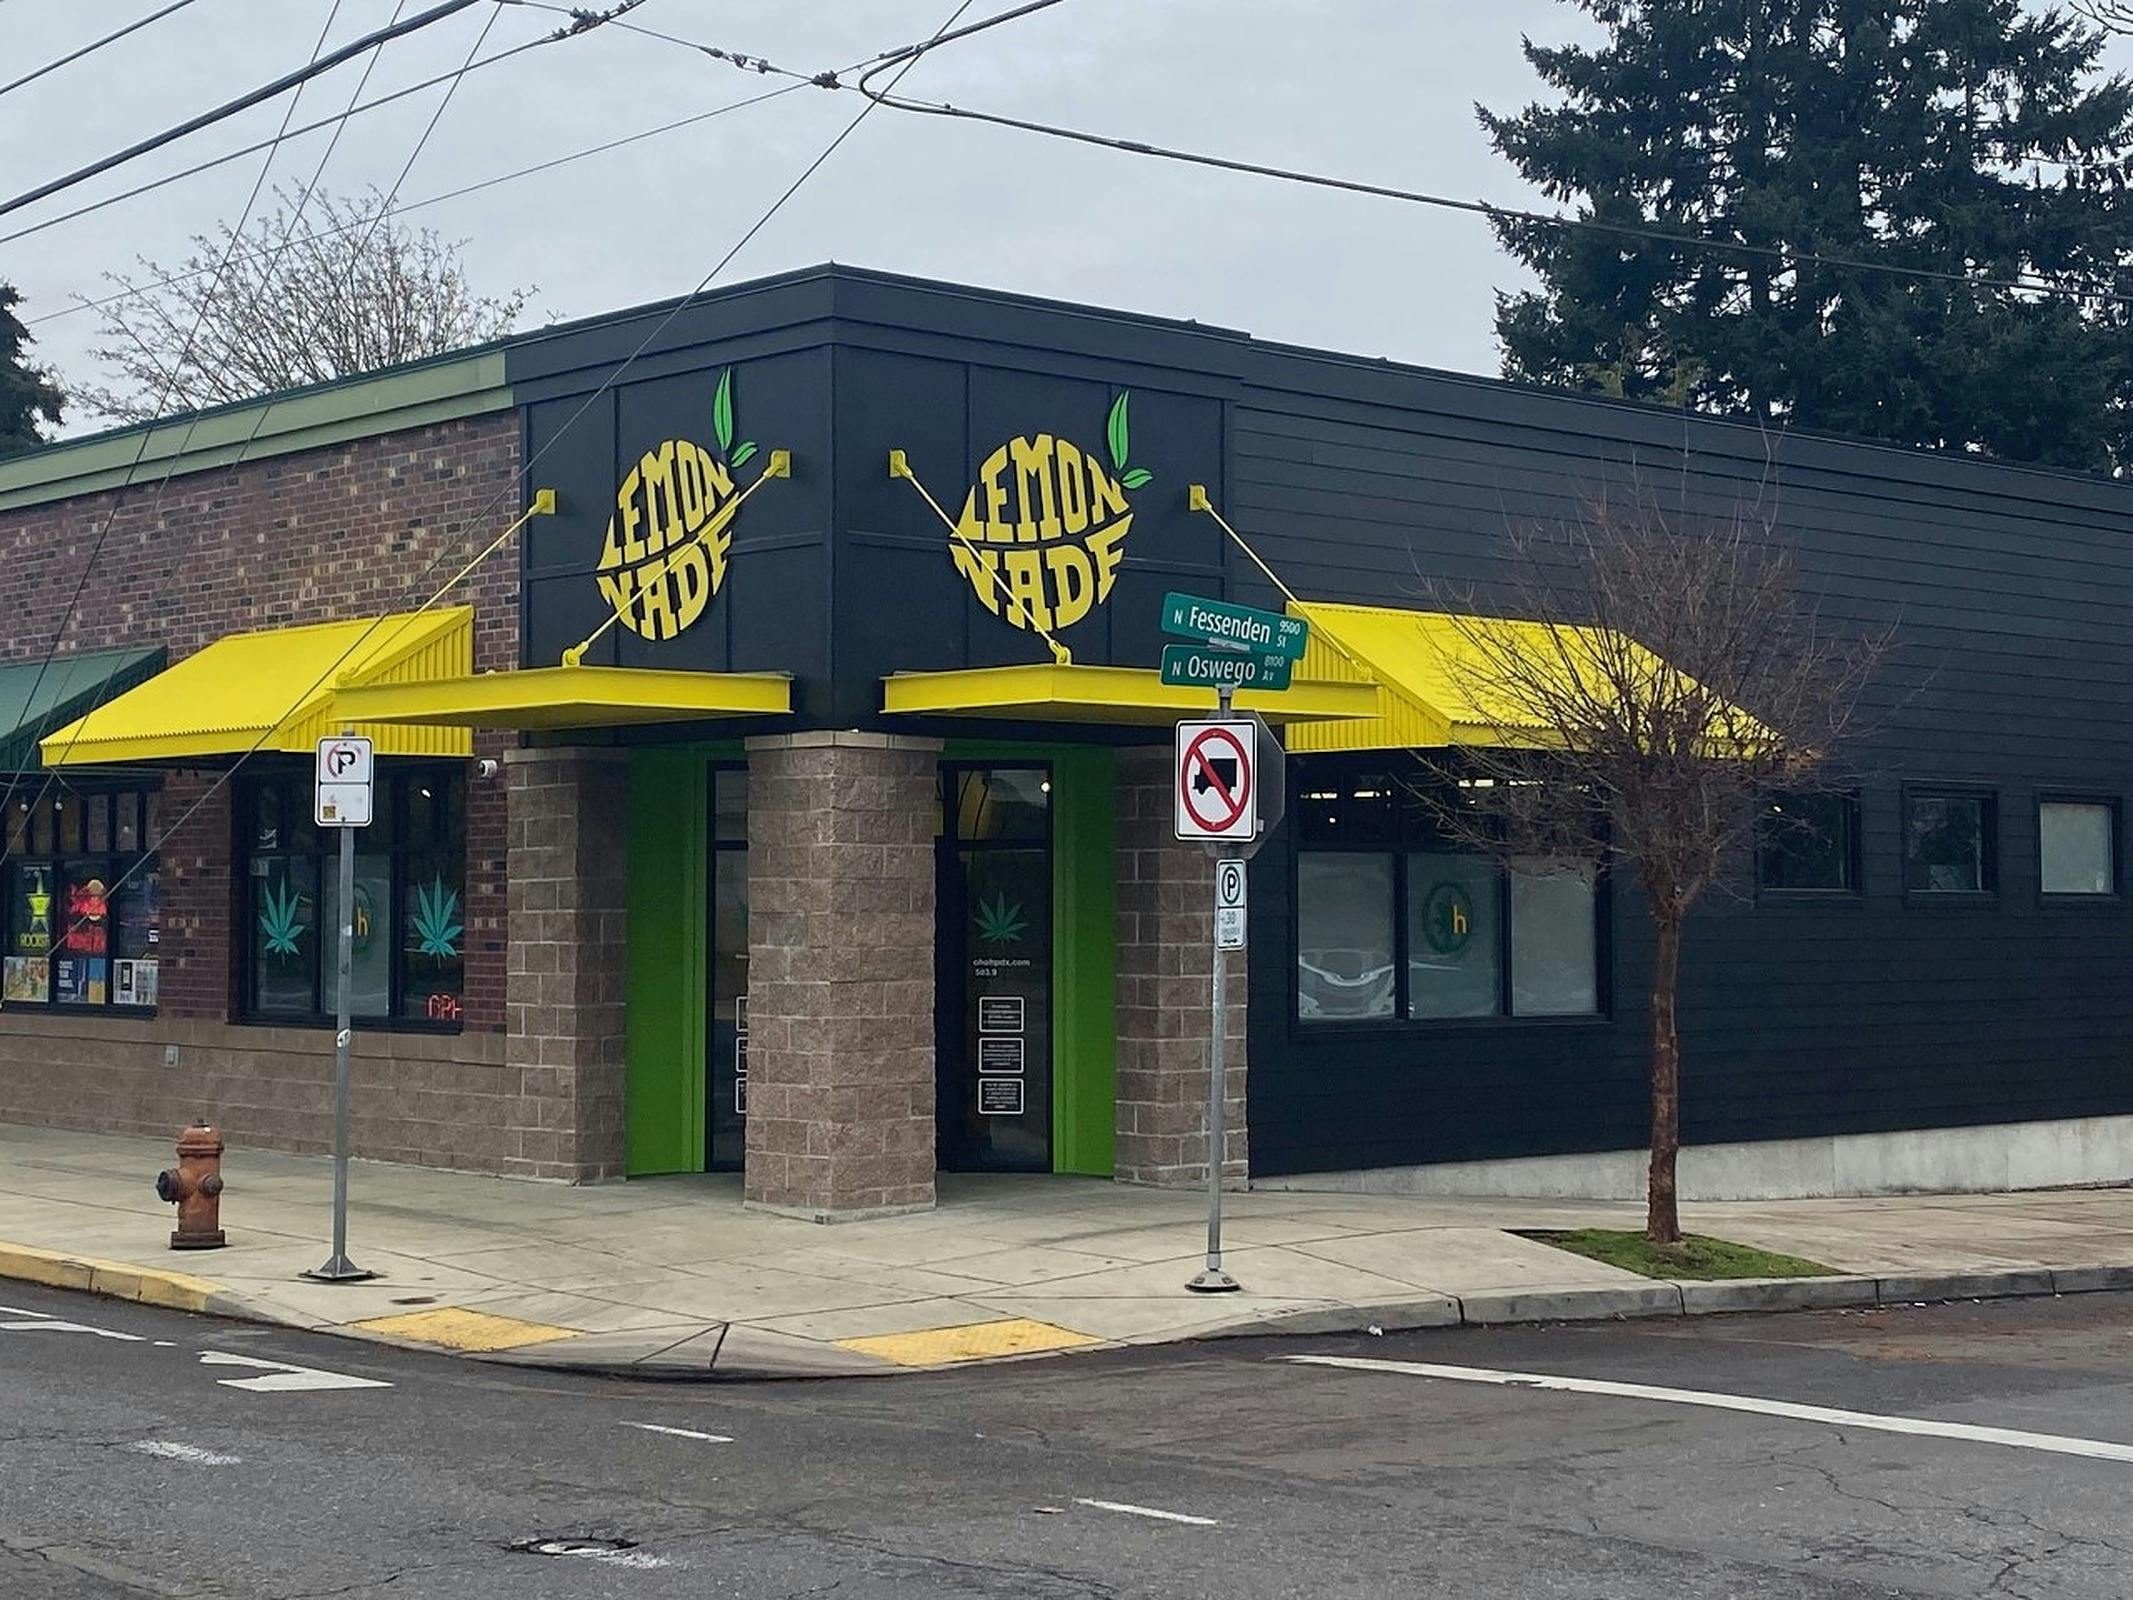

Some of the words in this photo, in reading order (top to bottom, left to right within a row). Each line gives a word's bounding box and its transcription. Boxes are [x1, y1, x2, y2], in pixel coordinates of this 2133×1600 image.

[597, 440, 735, 570] LEMON
[950, 434, 1130, 543] LEMON
[596, 491, 740, 640] NADE
[949, 513, 1134, 632] NADE
[1172, 661, 1182, 676] N
[1187, 655, 1256, 685] Oswego
[1174, 609, 1182, 625] N
[1189, 606, 1271, 644] Fessenden
[1279, 619, 1301, 635] 9500
